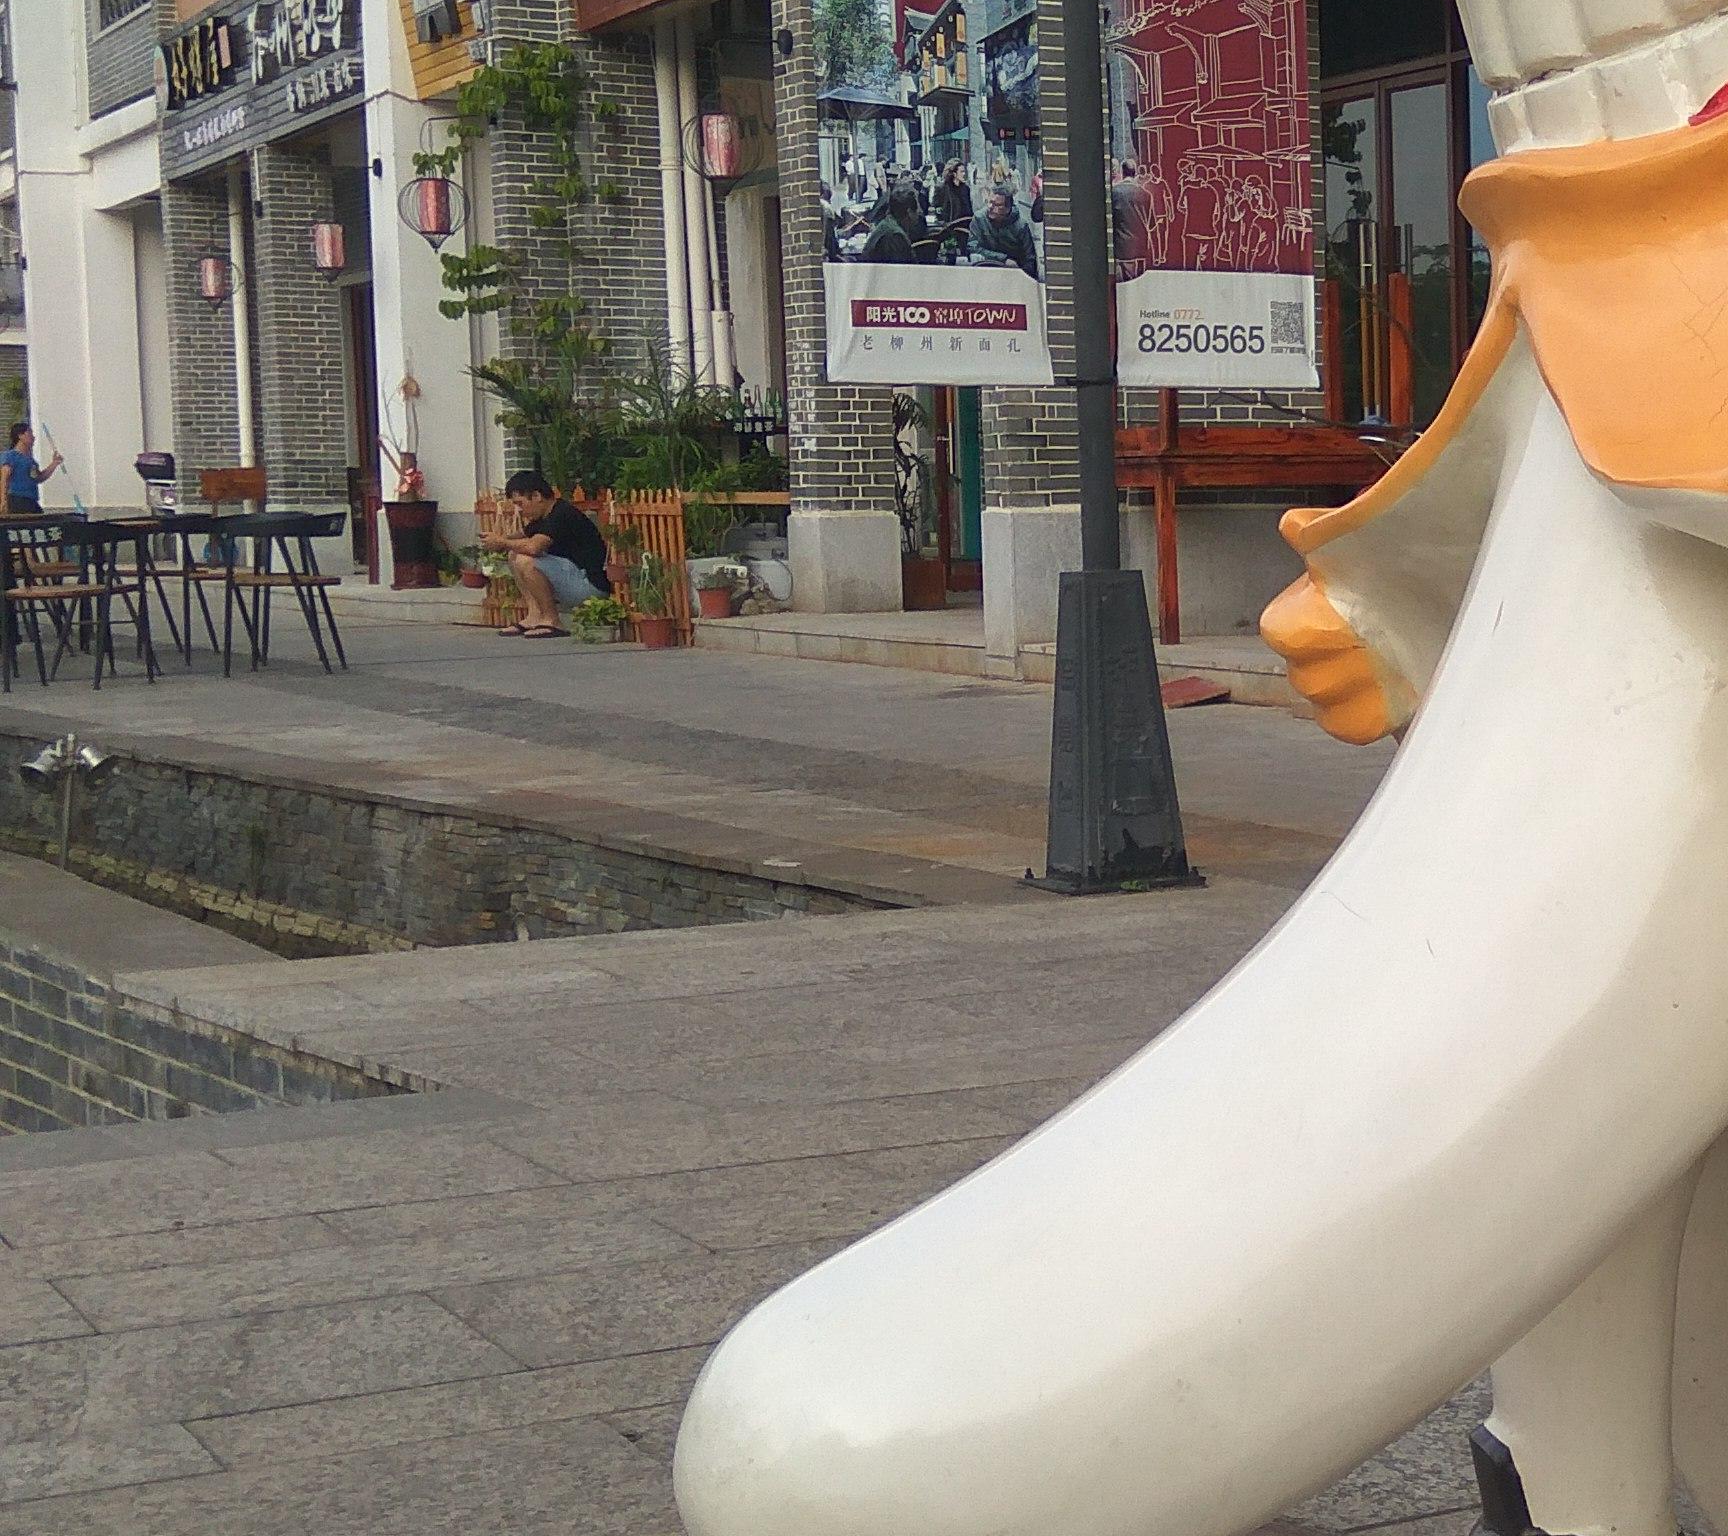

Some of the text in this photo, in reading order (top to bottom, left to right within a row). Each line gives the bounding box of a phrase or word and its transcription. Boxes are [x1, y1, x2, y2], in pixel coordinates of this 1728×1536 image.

[866, 306, 930, 324] 阳光100
[1139, 309, 1170, 319] Hotline
[860, 335, 1021, 353] 老柳州新面孔
[1138, 323, 1265, 354] 8250565
